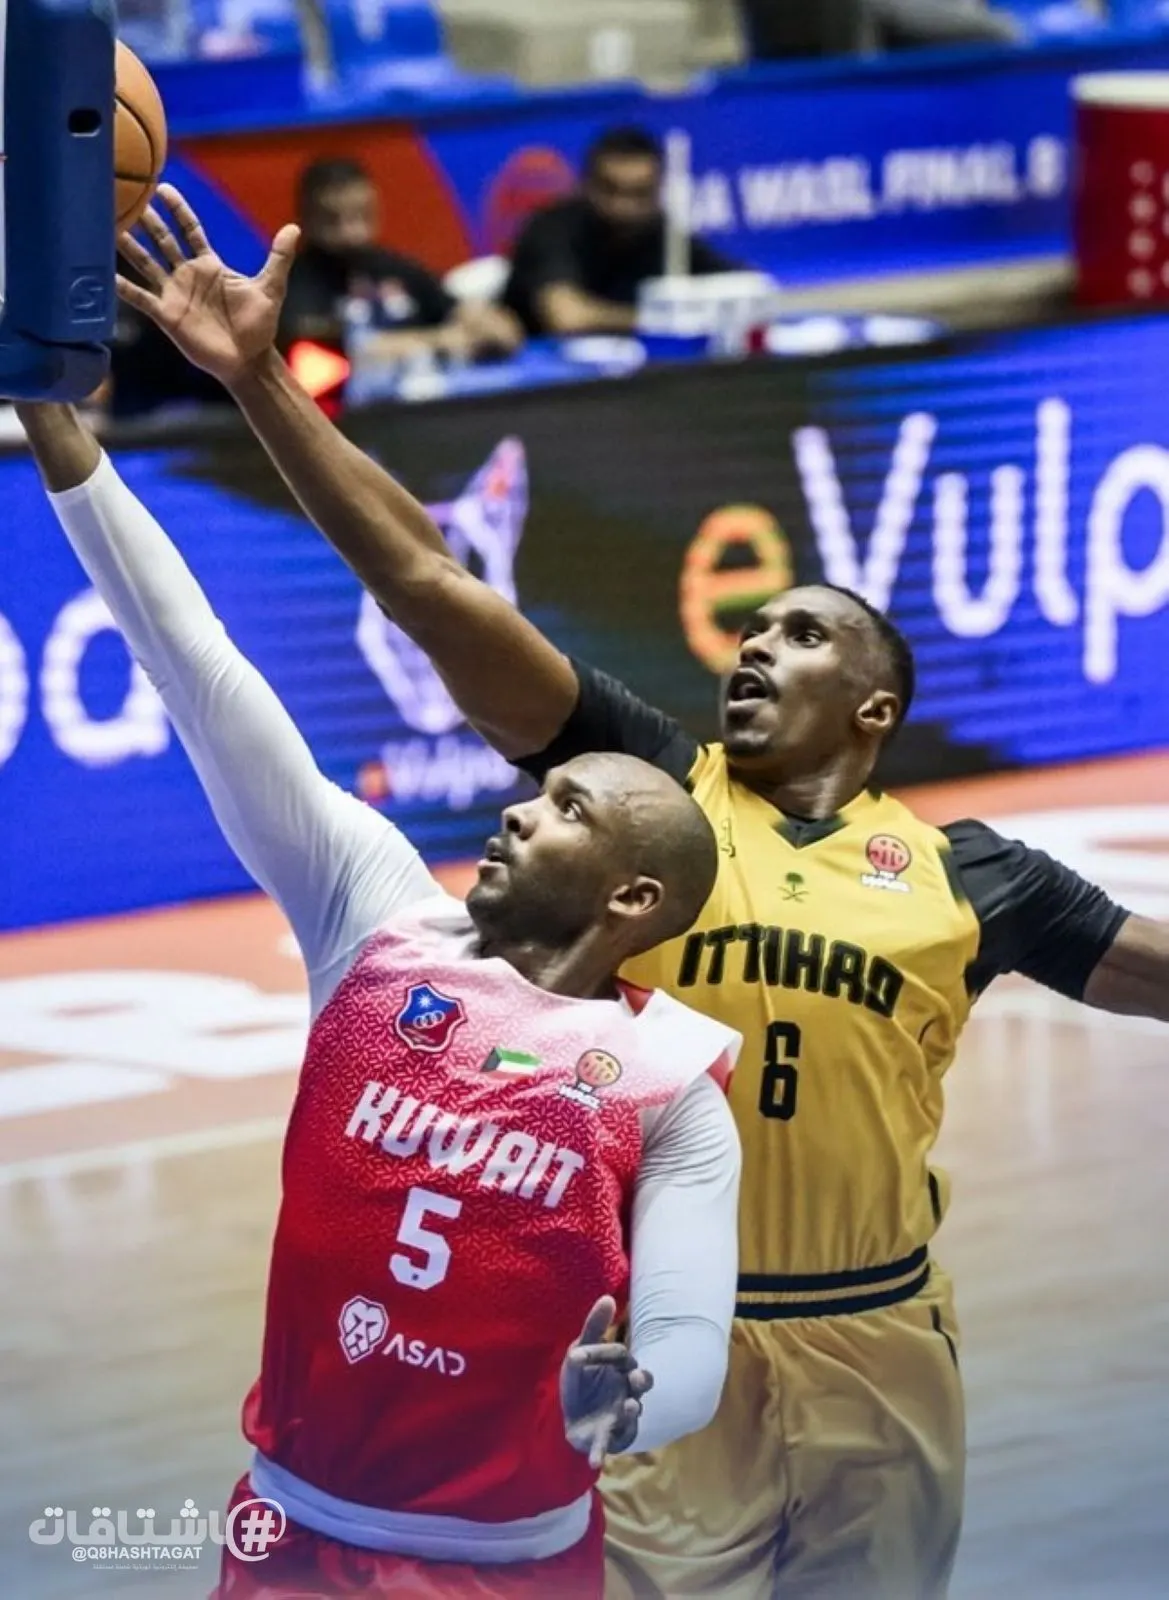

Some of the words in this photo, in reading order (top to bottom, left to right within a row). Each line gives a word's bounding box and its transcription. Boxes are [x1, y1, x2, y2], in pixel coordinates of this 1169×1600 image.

[679, 396, 1169, 687] eVulp
[677, 922, 905, 1019] ITTIHAD
[758, 1020, 802, 1121] 6
[344, 1080, 585, 1209] KUWAIT
[388, 1187, 462, 1291] 5
[383, 1333, 467, 1378] ASAD
